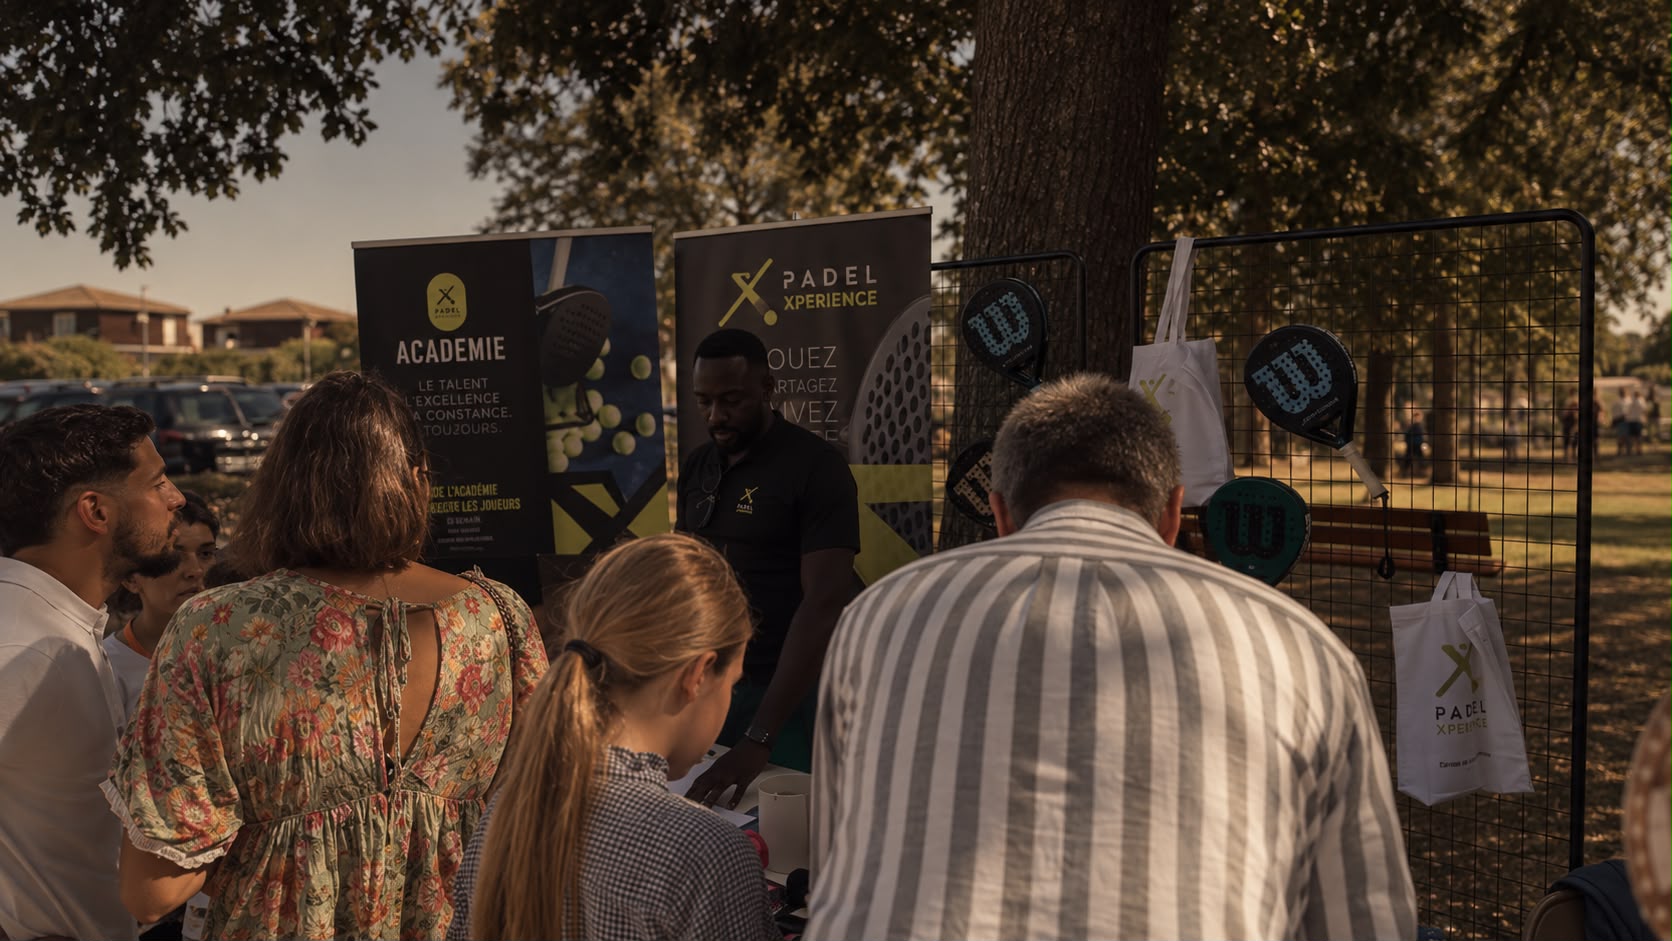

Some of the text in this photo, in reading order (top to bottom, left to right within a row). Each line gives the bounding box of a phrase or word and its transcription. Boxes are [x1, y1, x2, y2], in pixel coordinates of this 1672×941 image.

[783, 265, 877, 289] PADEL
[783, 290, 878, 311] XPERIENCE
[396, 336, 505, 364] ACADEMIE
[766, 346, 837, 371] OUEZ
[418, 378, 489, 392] LE TALENT
[773, 377, 838, 394] RTAGEZ
[405, 392, 501, 408] L'EXCELLENCE
[426, 407, 512, 421] CONSTANCE.
[769, 400, 838, 423] IVEZ
[447, 482, 498, 497] L'ACADÉMIE
[461, 500, 478, 512] LES
[480, 497, 521, 512] JOUEURS
[1435, 700, 1487, 721] PADEL
